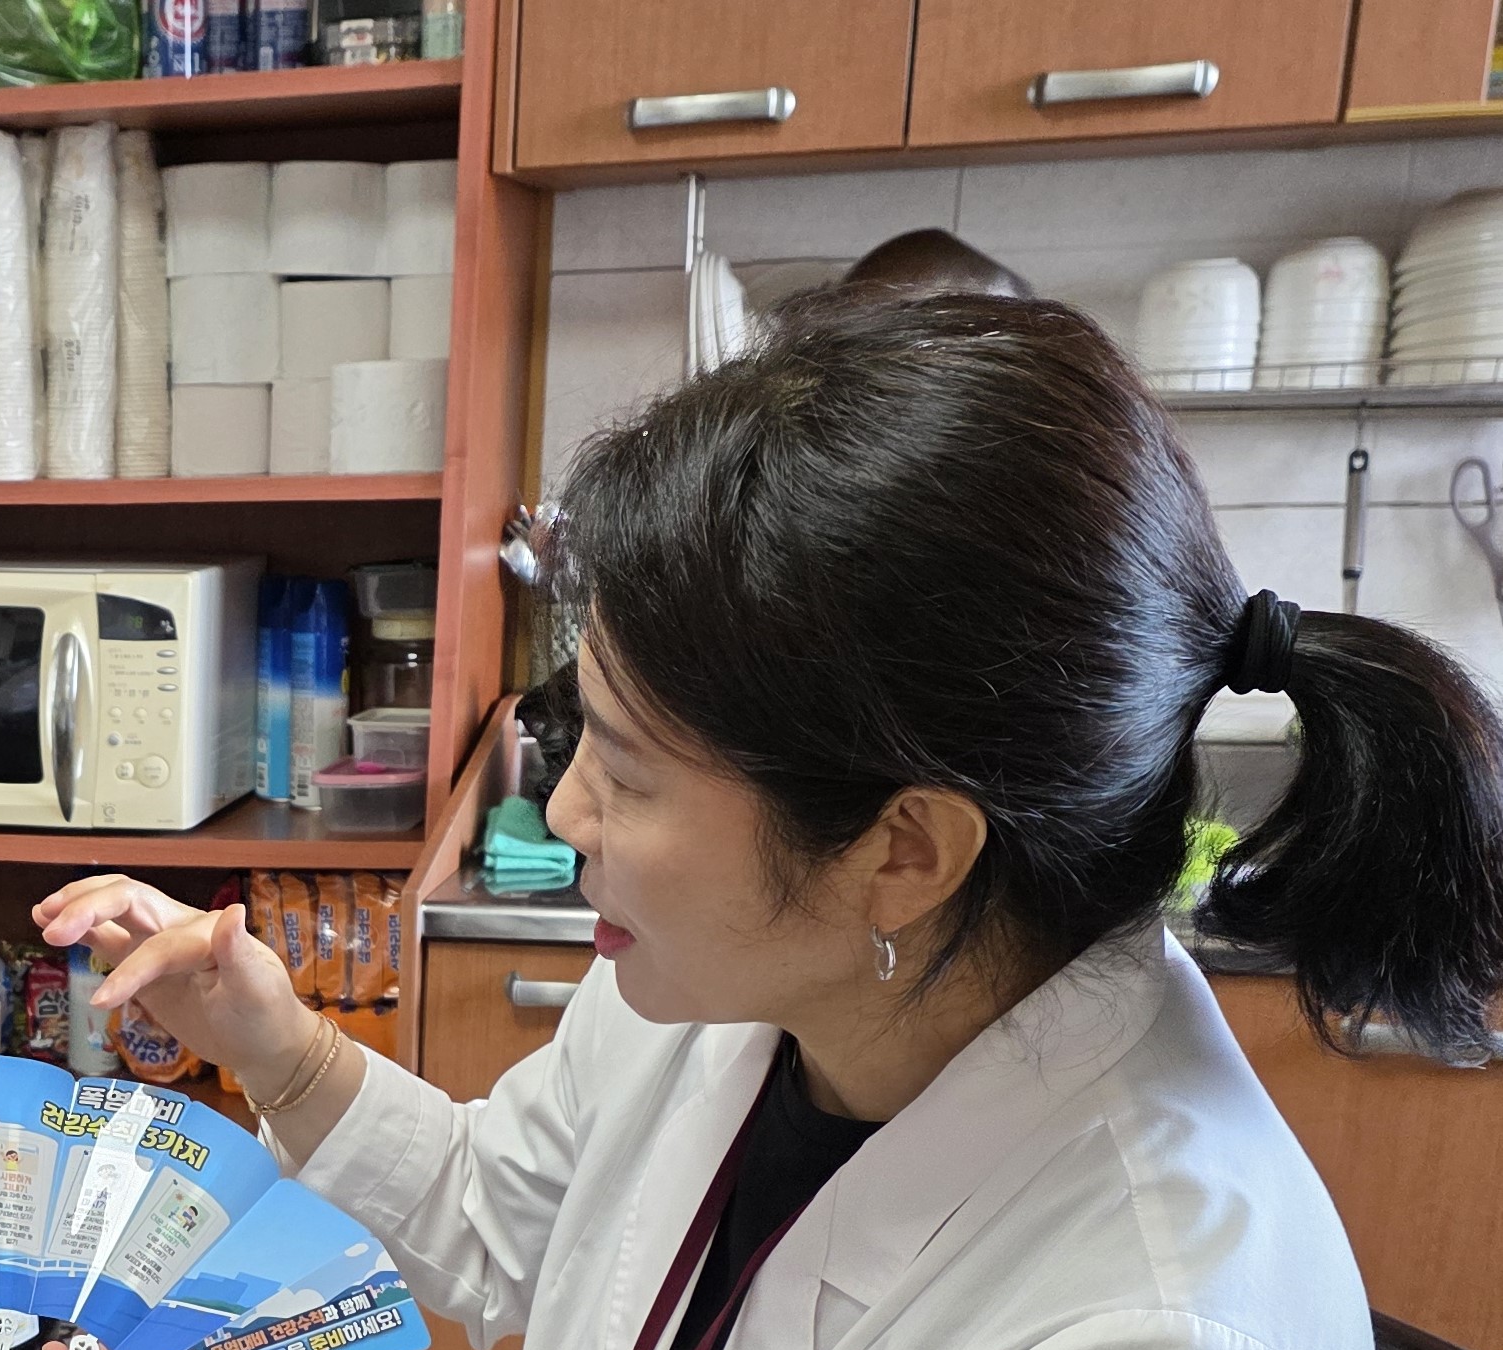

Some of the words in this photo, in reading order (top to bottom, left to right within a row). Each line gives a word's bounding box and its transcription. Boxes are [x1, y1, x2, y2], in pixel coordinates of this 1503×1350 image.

[40, 1101, 140, 1144] 건강수칙
[139, 1126, 210, 1172] 3가지
[269, 1305, 339, 1341] 건강수칙과
[339, 1292, 371, 1317] 함께
